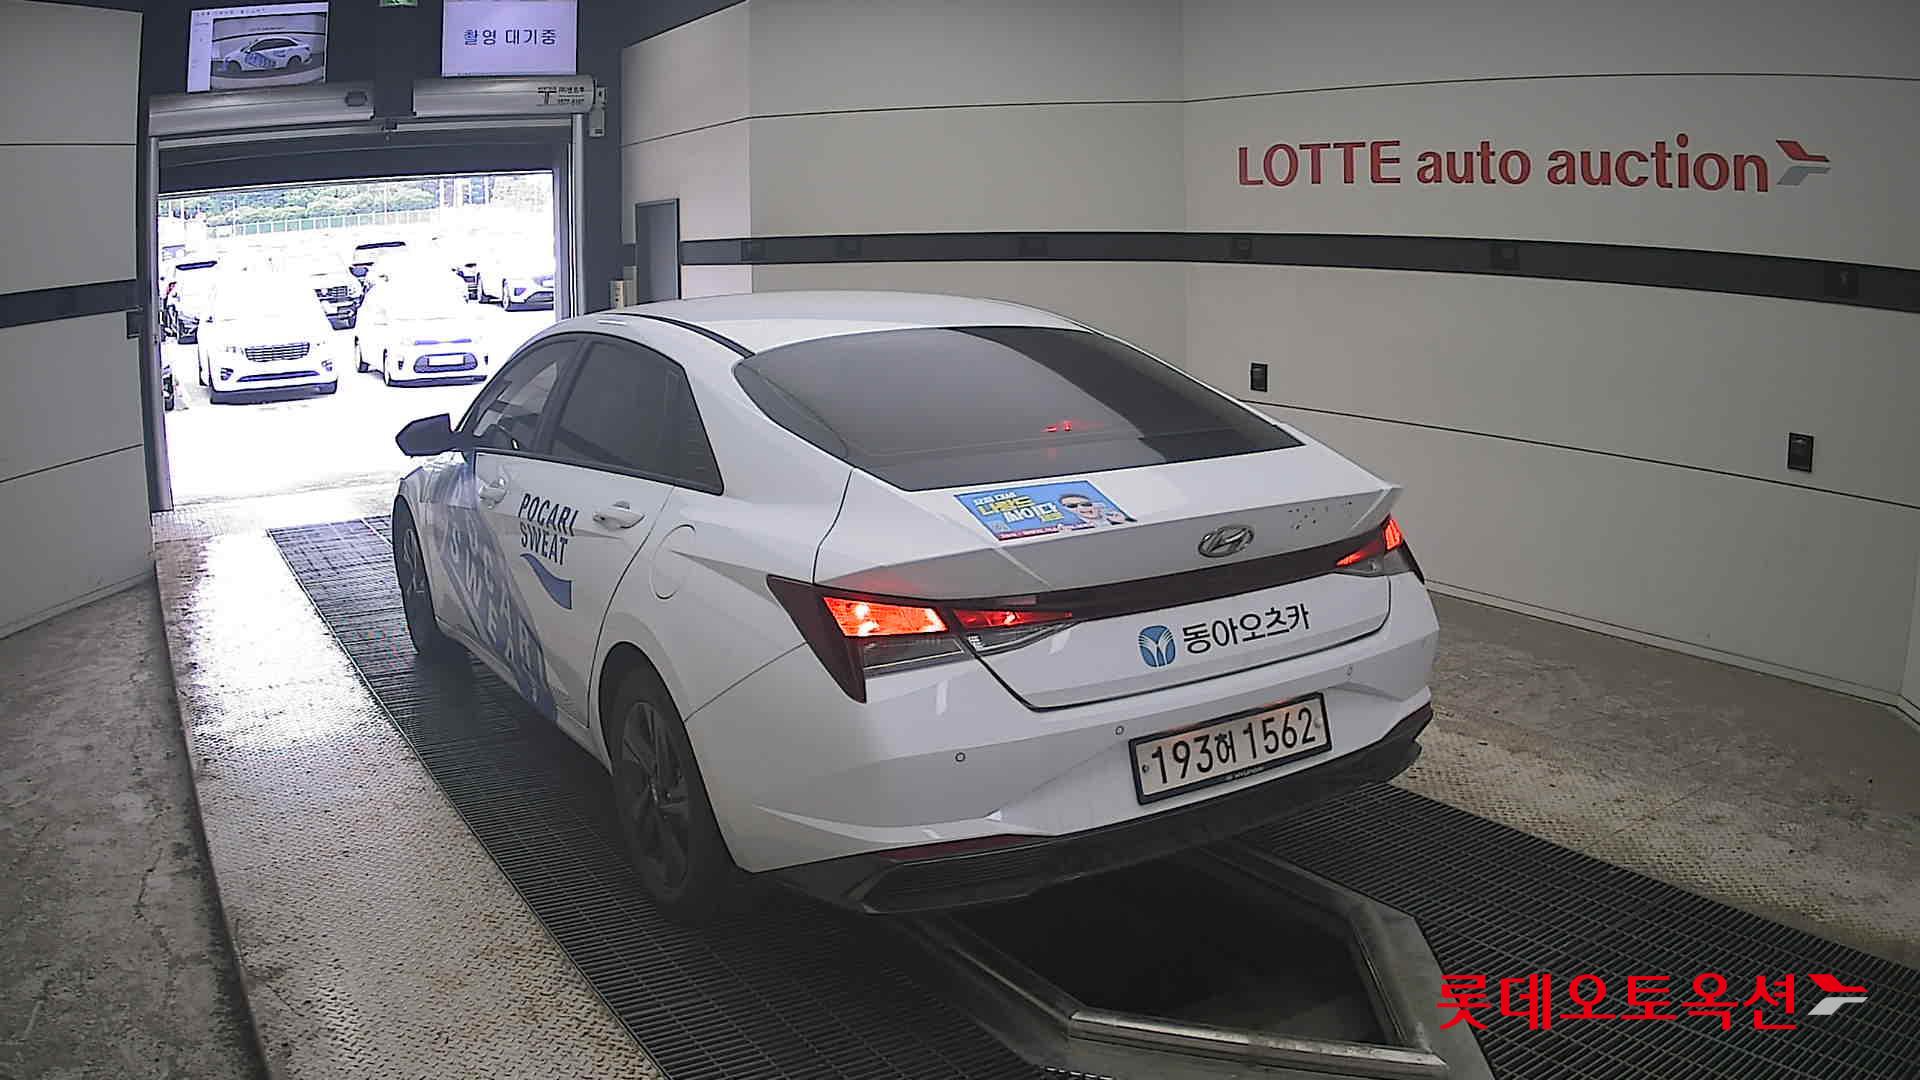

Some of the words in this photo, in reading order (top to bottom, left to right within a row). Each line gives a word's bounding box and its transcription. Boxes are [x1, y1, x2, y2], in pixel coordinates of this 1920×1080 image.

[464, 29, 497, 46] 촬영
[505, 29, 557, 45] 대기중
[1238, 140, 1401, 186] LOTTE
[1416, 140, 1532, 185] auto
[1547, 133, 1769, 192] auction
[518, 492, 580, 537] POCARI
[519, 521, 568, 566] SWEAT
[1183, 603, 1309, 654] 동아오츠카
